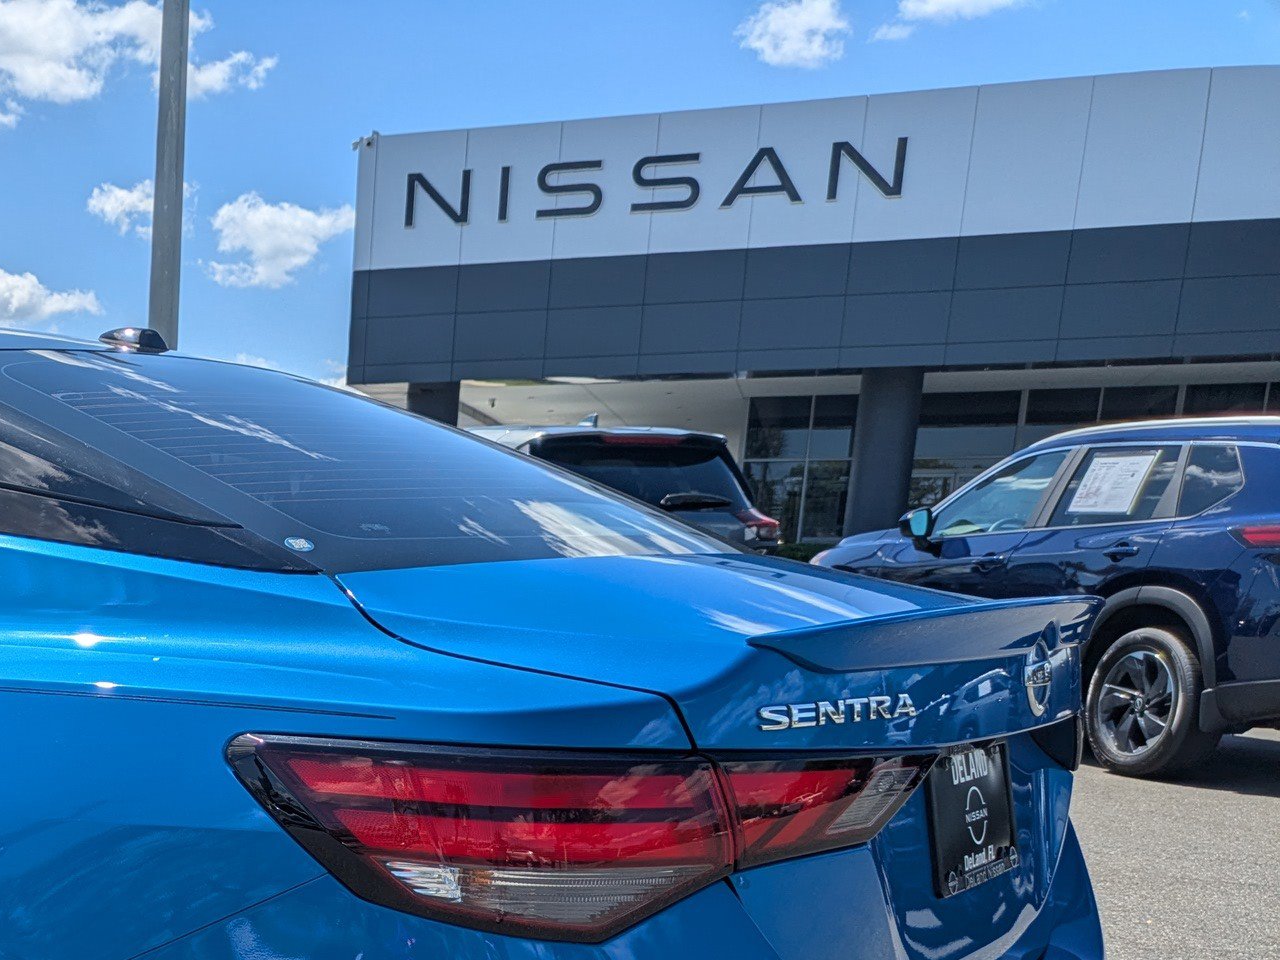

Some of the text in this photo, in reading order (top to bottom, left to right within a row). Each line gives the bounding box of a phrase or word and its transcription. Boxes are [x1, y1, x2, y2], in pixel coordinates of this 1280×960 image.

[404, 136, 909, 228] NISSAN
[759, 693, 917, 731] SENTRA
[951, 749, 988, 785] DELAND
[965, 808, 988, 824] NISSAN
[987, 844, 996, 862] FL
[965, 869, 988, 890] DeLand
